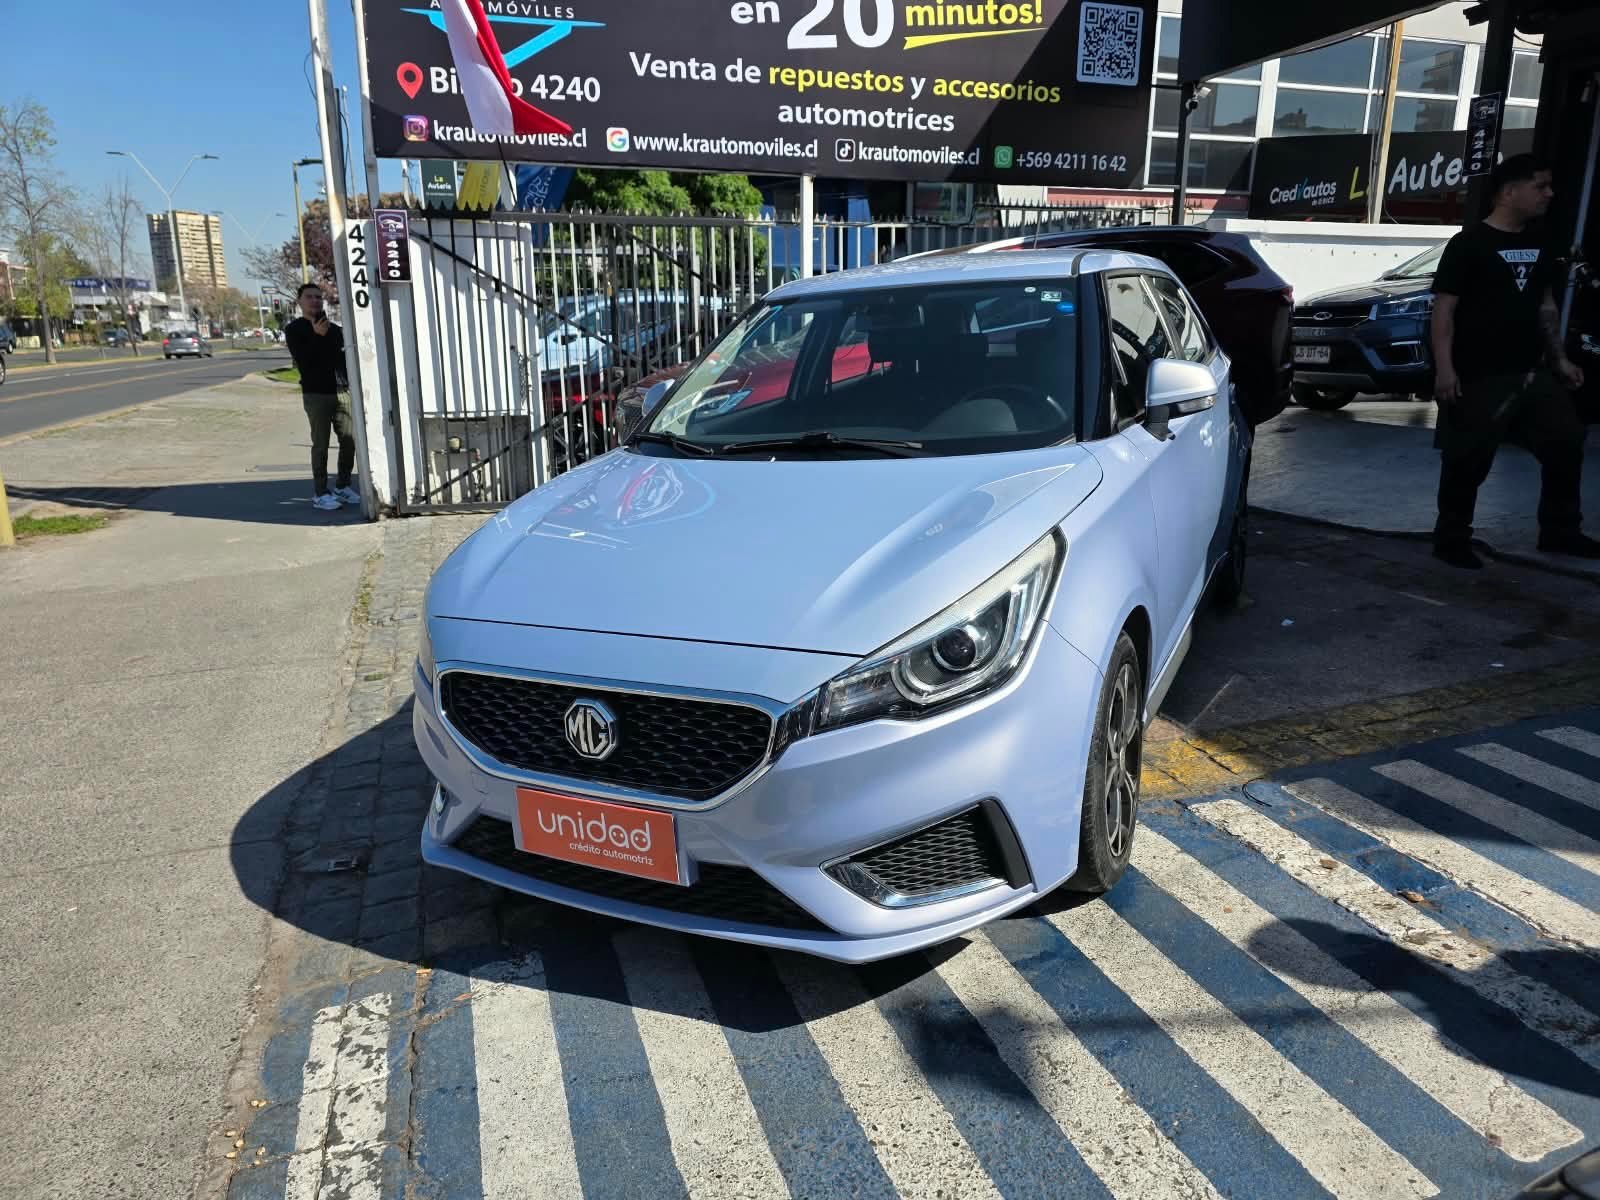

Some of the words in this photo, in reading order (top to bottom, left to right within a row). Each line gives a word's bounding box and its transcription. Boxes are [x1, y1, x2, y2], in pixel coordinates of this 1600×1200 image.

[430, 0, 575, 19] AMÓVILES
[731, 2, 780, 25] en
[786, 0, 896, 49] 20
[905, 0, 1043, 27] minutos!
[429, 66, 524, 97] Bio
[530, 73, 601, 104] 4240
[629, 51, 718, 83] Venta
[724, 57, 761, 84] de
[768, 63, 905, 94] repuestos
[910, 74, 927, 99] y
[933, 76, 1062, 104] accesorios
[777, 101, 956, 133] automotrices
[633, 133, 819, 159] www.krautomoviles.cl
[858, 141, 981, 167] krautomoviles.cl
[1016, 152, 1052, 169] +569
[1055, 153, 1088, 170] 4211
[1091, 154, 1107, 170] 16
[1108, 155, 1128, 171] 42
[1471, 129, 1486, 171] 4240
[433, 175, 444, 183] La
[1349, 166, 1370, 201] L
[348, 223, 370, 309] 4240
[386, 240, 401, 278] 4240
[1505, 251, 1537, 261] GUESS
[566, 703, 609, 754] MG
[537, 808, 652, 853] unidad
[569, 841, 602, 856] crédito
[603, 848, 655, 867] automotriz
